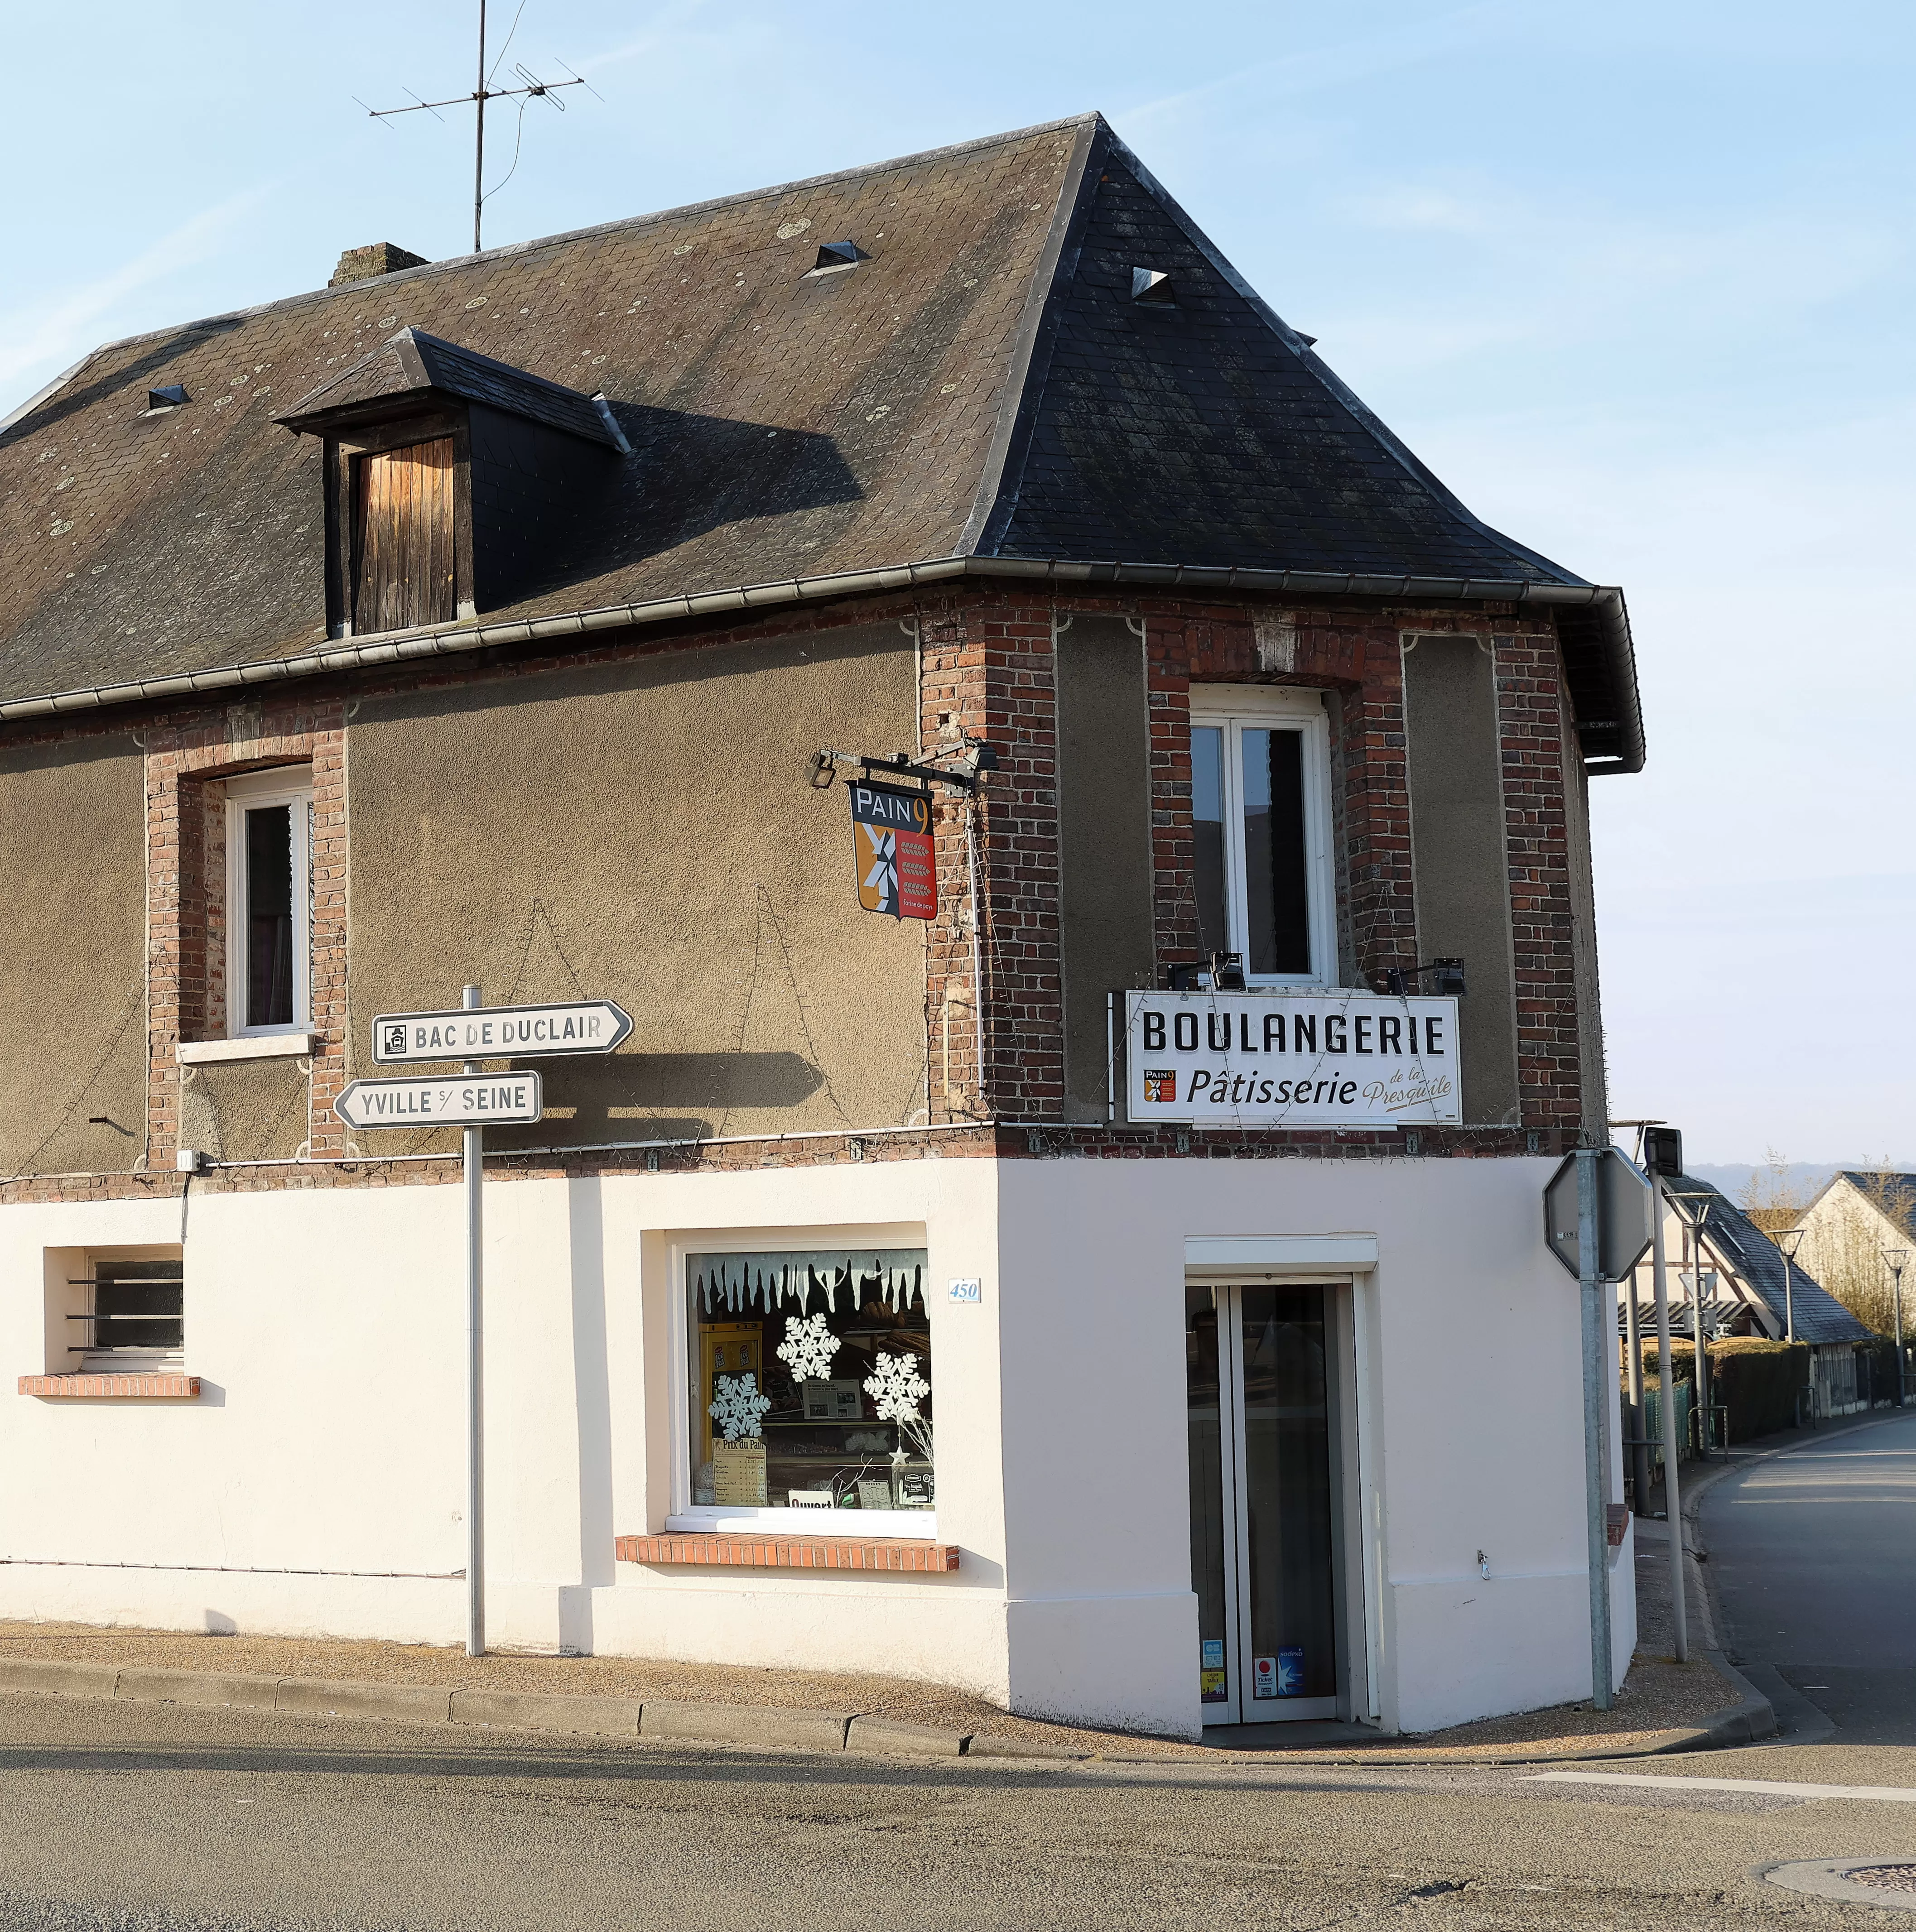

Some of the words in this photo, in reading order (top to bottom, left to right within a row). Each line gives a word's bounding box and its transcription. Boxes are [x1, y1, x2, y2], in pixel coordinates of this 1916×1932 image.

[415, 1025, 456, 1048] BAC
[466, 1023, 493, 1045] DE
[503, 1016, 601, 1043] DUCLAIR
[1143, 1011, 1444, 1055] BOULANGERIE
[1186, 1069, 1358, 1104] Pâtisserie
[1390, 1069, 1403, 1084] de
[1407, 1067, 1420, 1081] la
[362, 1091, 431, 1115] YVILLE
[462, 1086, 525, 1110] SEINE
[950, 1283, 977, 1297] 450
[723, 1440, 737, 1449] Prix
[739, 1439, 749, 1449] du
